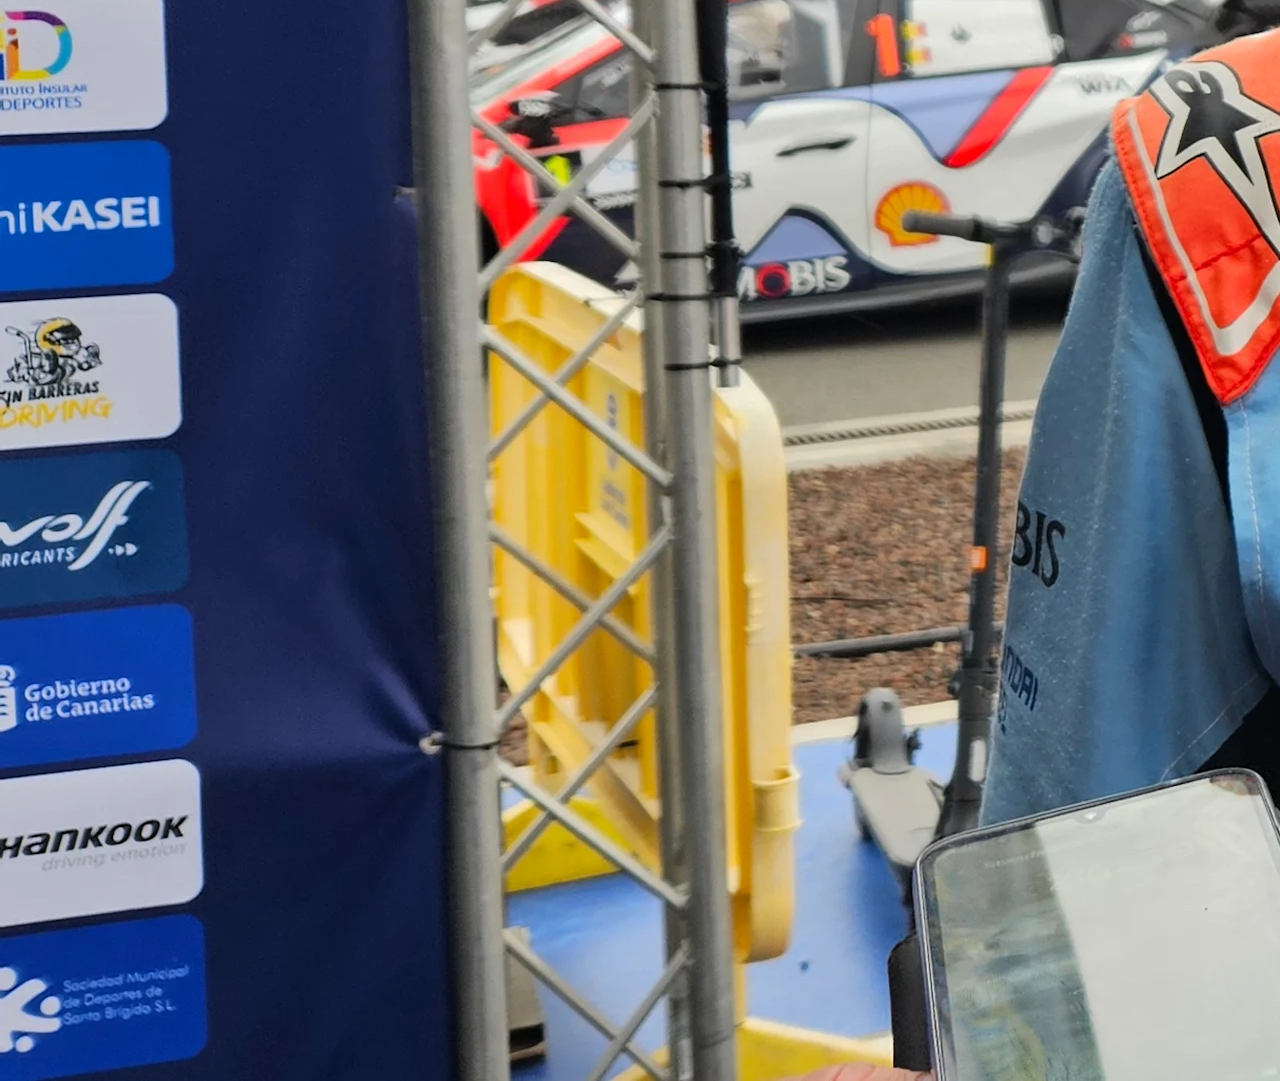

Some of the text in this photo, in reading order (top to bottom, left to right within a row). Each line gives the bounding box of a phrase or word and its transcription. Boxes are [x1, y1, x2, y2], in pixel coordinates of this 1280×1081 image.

[28, 380, 100, 400] BARRERAS
[24, 677, 132, 703] Gobierno
[25, 693, 156, 722] de Canarias
[42, 841, 187, 871] driving emotion
[63, 964, 190, 993] Sociedad Municipal
[64, 984, 164, 1009] de Deportes de
